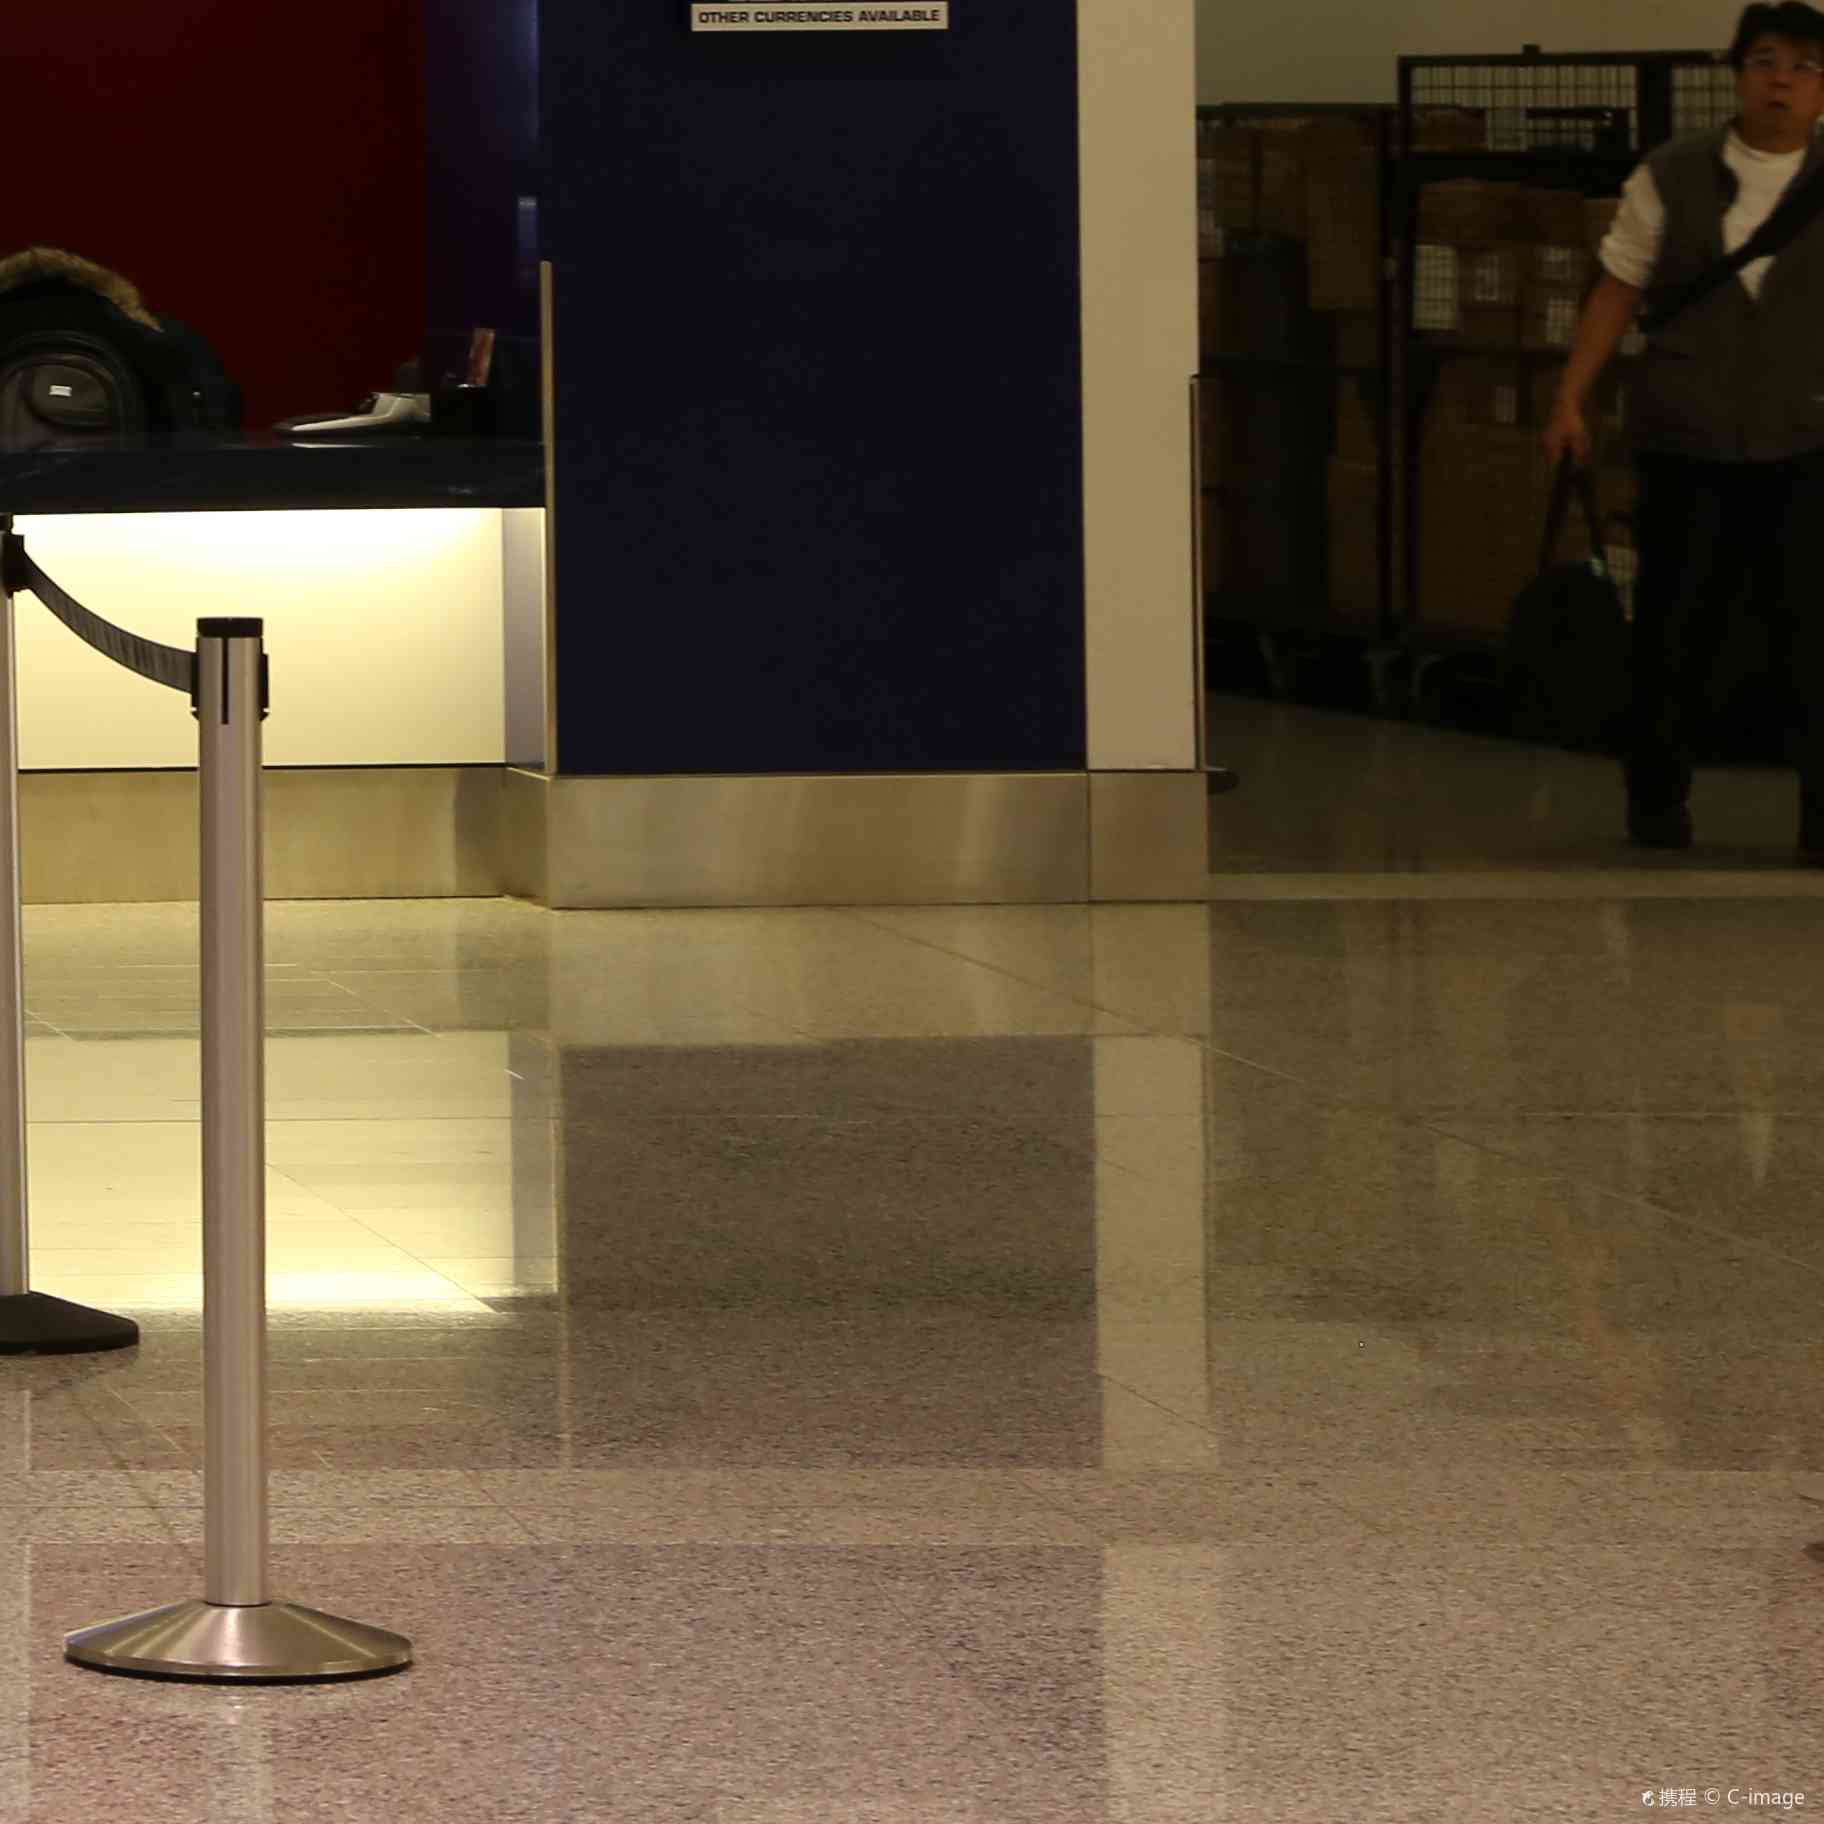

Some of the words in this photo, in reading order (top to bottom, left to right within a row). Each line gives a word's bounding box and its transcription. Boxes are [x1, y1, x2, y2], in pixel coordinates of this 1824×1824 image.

[699, 11, 749, 23] OTHER
[754, 10, 852, 23] CURRENCIES
[859, 9, 940, 22] AVAILABLE
